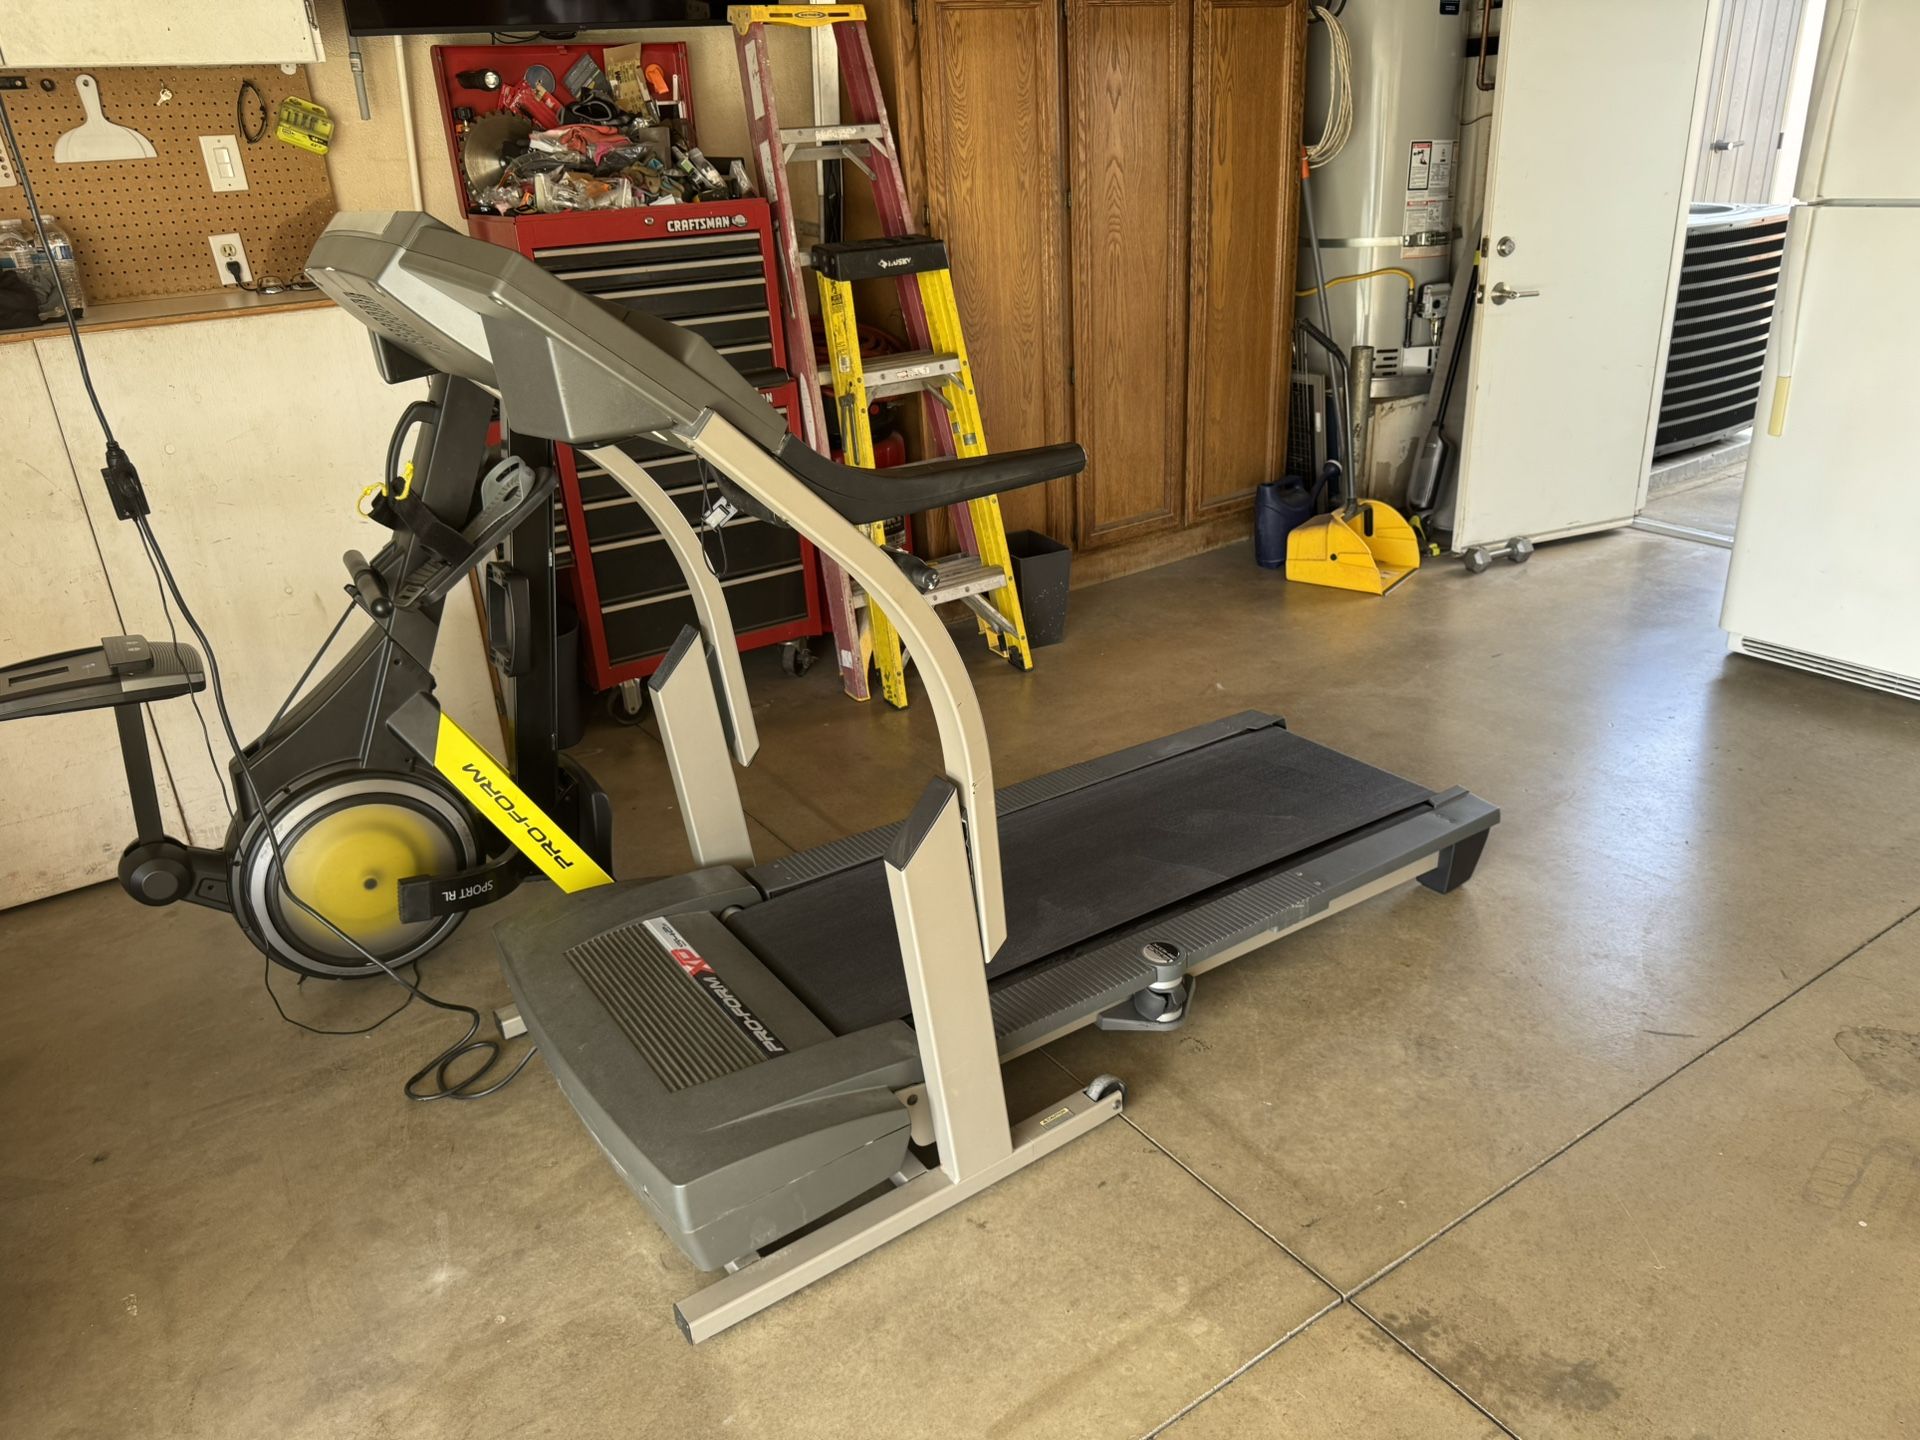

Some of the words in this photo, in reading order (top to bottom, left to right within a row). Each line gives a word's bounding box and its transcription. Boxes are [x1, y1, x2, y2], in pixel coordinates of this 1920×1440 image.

[666, 215, 730, 232] CRAFTSMAN
[461, 763, 574, 870] PRO-FORM
[441, 889, 457, 902] RL
[458, 879, 494, 900] SPORT
[671, 948, 717, 977] XP
[703, 976, 785, 1052] PRO-FORM
